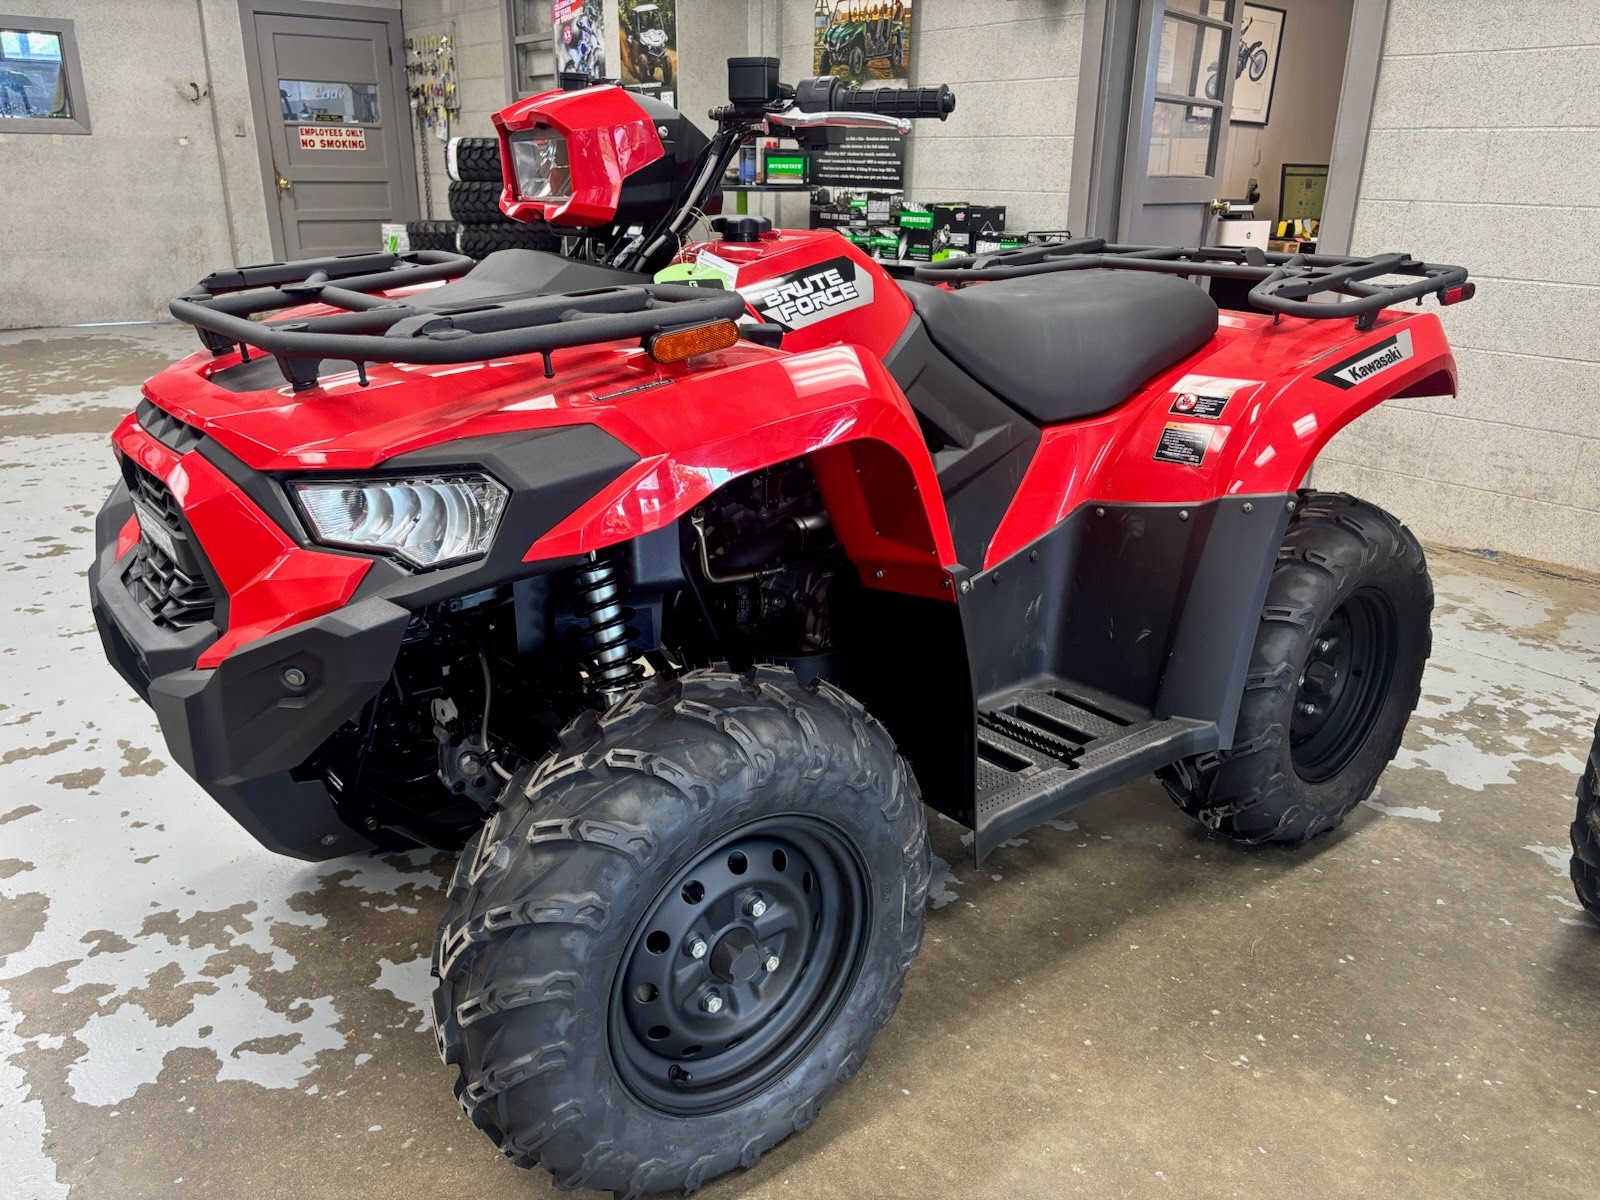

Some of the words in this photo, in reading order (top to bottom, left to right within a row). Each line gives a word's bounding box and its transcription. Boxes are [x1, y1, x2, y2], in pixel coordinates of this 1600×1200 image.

[300, 128, 343, 137] EMPLOYEES
[345, 129, 363, 137] ONLY
[302, 139, 315, 148] NO
[320, 139, 365, 148] SMOKING
[901, 216, 931, 224] INTERSTATE
[763, 268, 844, 308] BRUTE
[777, 281, 859, 322] FORCE
[1348, 346, 1403, 381] Kawasaki
